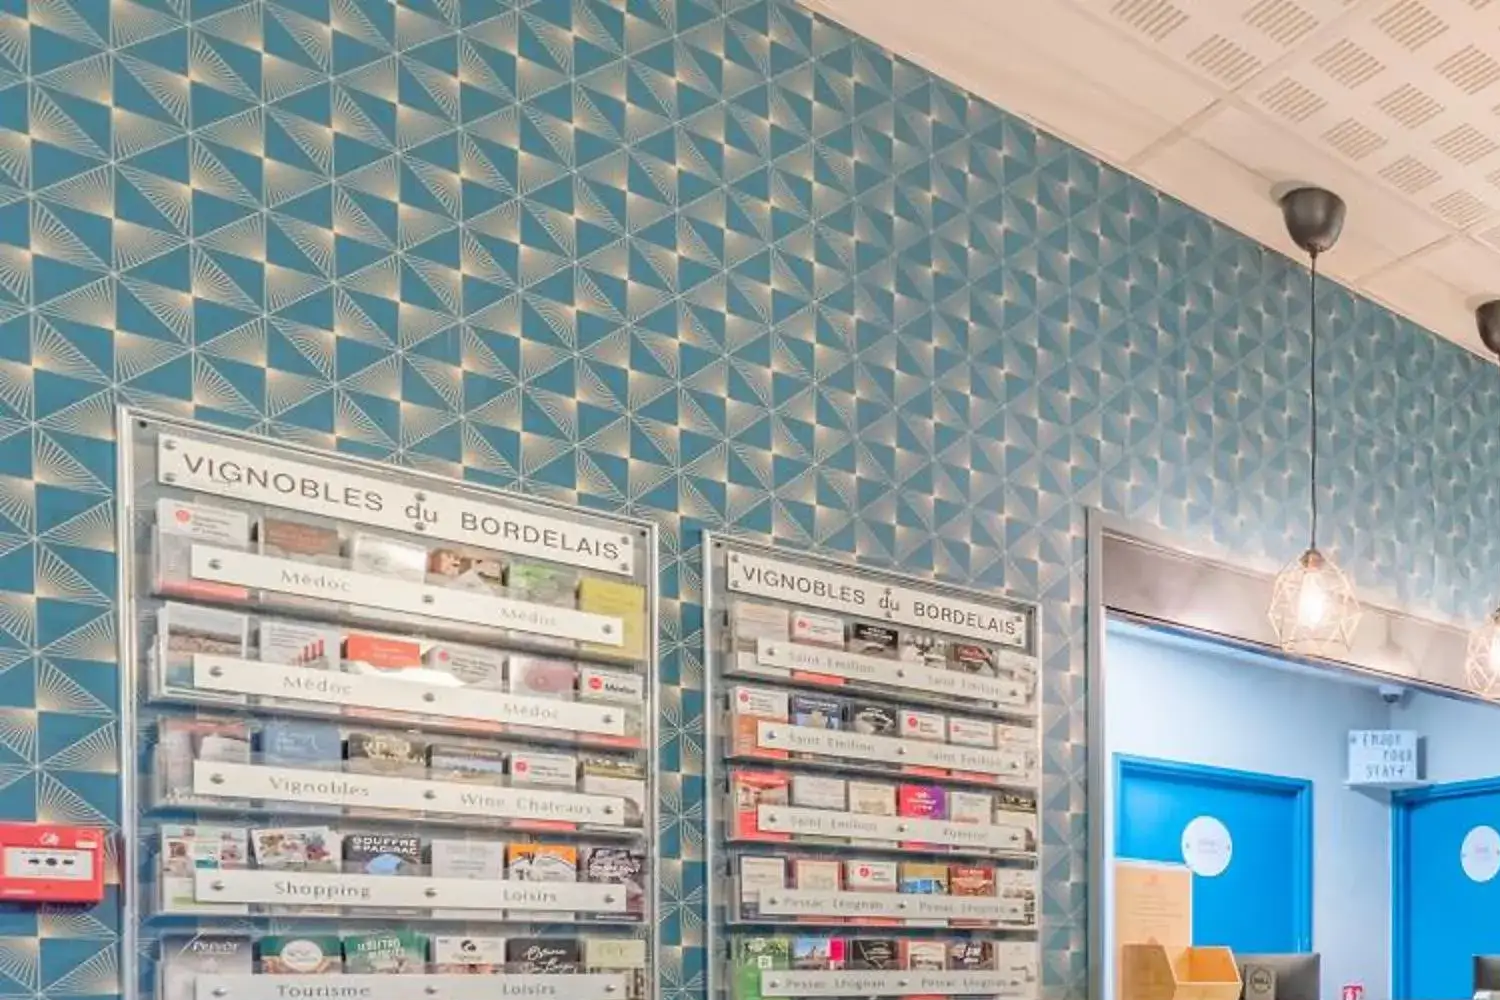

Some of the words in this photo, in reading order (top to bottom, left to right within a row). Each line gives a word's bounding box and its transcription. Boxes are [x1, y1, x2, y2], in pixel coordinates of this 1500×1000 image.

[183, 452, 384, 512] VIGNOBLES
[404, 501, 438, 525] du
[460, 511, 620, 561] BORDELAIS
[742, 565, 866, 605] VIGNOBLES
[879, 593, 900, 612] du
[913, 601, 1016, 635] BORDELAIS
[269, 775, 370, 798] Vignobles
[460, 791, 506, 808] Wine
[274, 880, 371, 899] Shopping
[503, 883, 557, 903] Loisirs
[276, 984, 371, 998] Tourisme
[503, 982, 556, 995] Loisirs
